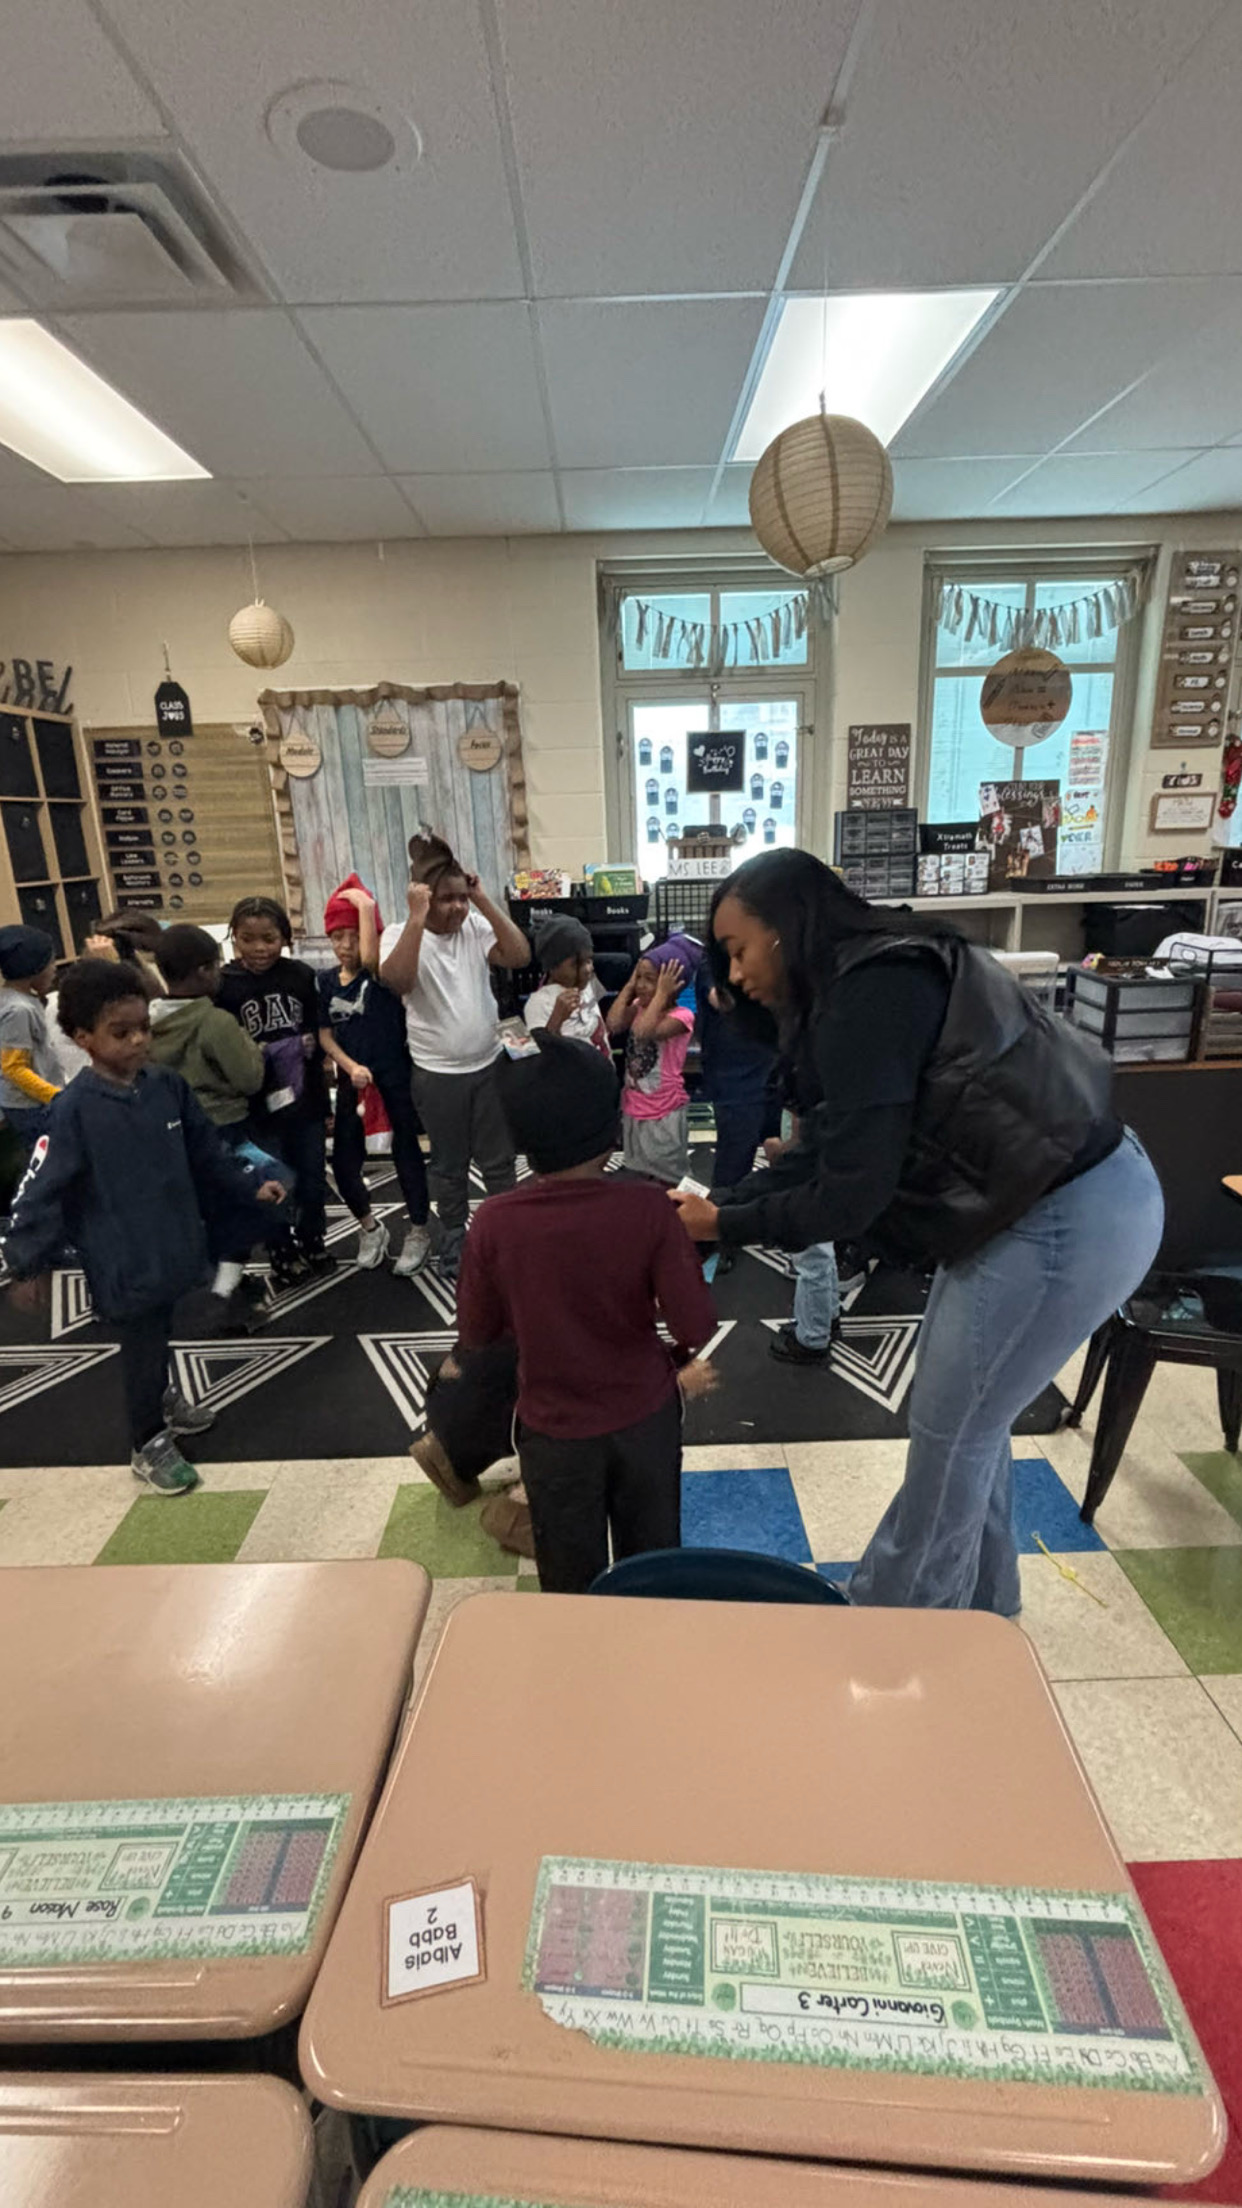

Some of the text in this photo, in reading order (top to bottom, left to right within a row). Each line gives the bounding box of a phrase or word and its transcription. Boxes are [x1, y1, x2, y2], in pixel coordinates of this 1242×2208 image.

[159, 702, 184, 710] CLASS
[852, 728, 888, 746] Today
[850, 747, 909, 760] GREAT DAY
[873, 759, 886, 767] TO
[852, 768, 906, 785] LEARN
[850, 785, 907, 796] SOMETHING
[943, 842, 968, 850] Treats
[669, 861, 718, 876] MS LEE
[530, 907, 552, 915] Books
[607, 907, 629, 915] Books
[30, 1901, 81, 1919] Mason
[85, 1899, 118, 1917] Rose
[427, 1906, 438, 1924] 2
[409, 1923, 457, 1948] Babb
[796, 1932, 868, 1951] YOURSELF
[405, 1942, 462, 1970] Albais
[922, 1942, 948, 1956] GIVE
[806, 1962, 868, 1981] BELIEVE
[797, 1992, 945, 2024] Giovanni Carter 3
